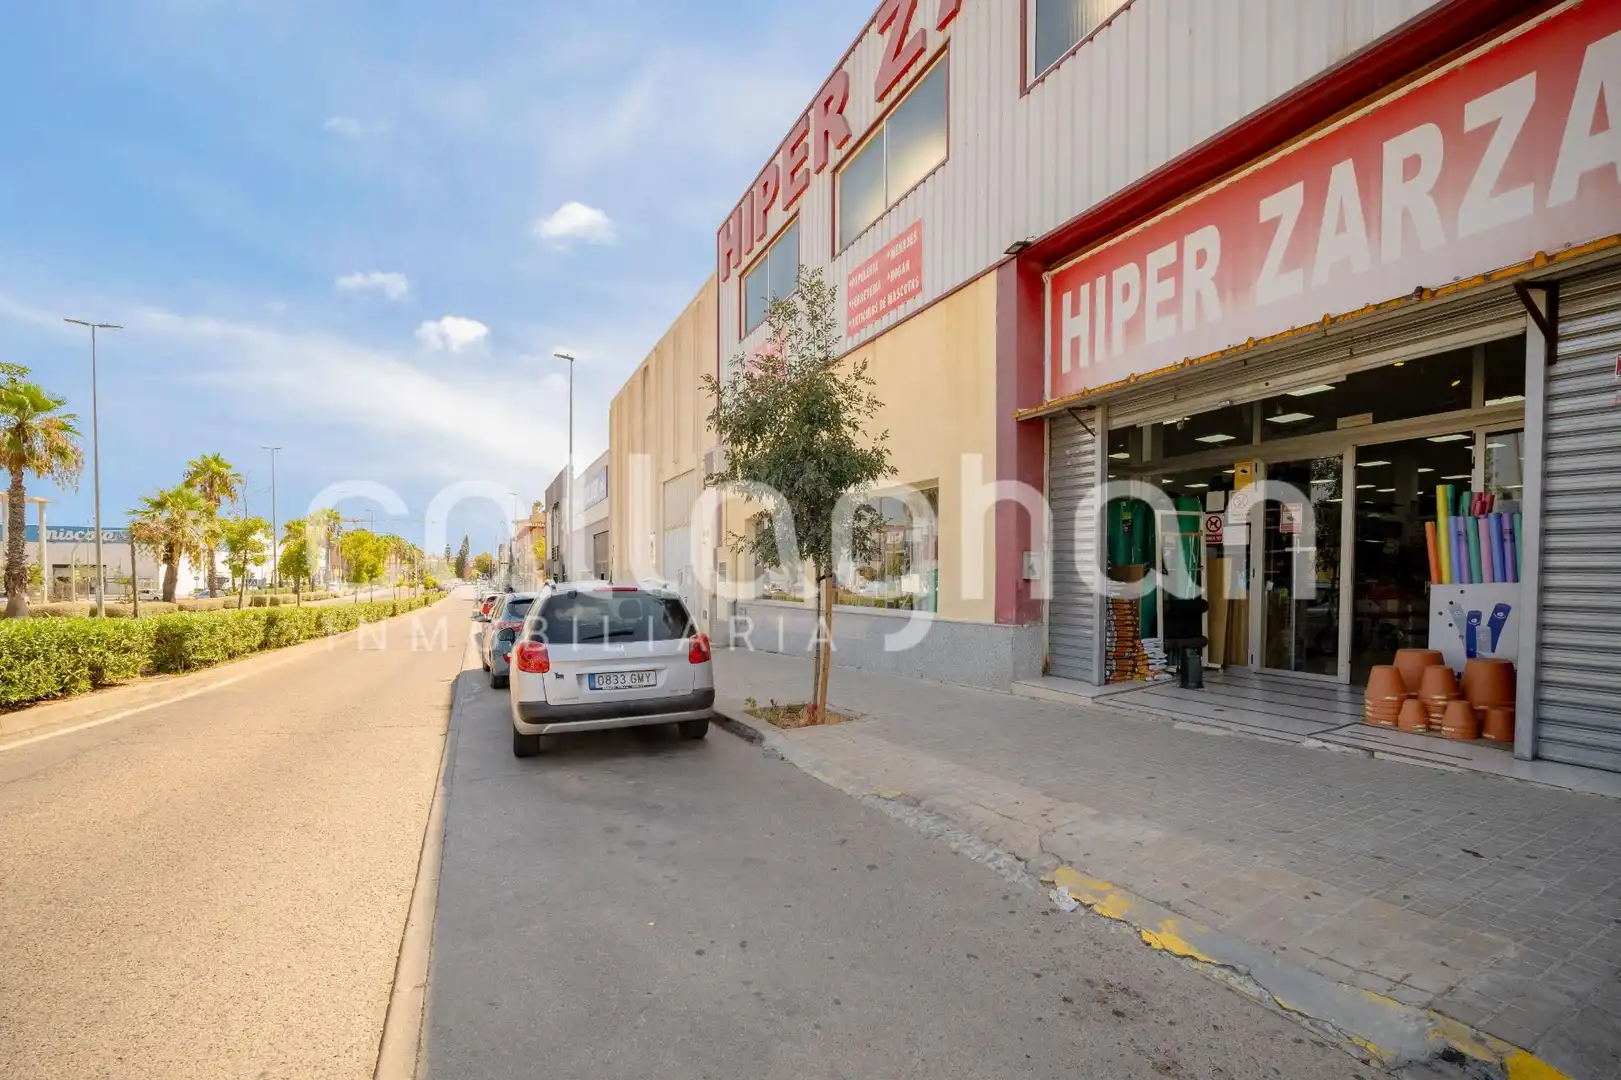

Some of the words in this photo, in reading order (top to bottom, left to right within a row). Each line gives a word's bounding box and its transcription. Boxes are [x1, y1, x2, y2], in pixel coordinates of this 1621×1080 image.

[718, 70, 852, 282] HIPER
[875, 0, 962, 103] Z
[1061, 225, 1223, 375] HIPER
[1255, 30, 1621, 305] ZARZA
[890, 260, 910, 283] HOGAR
[880, 296, 887, 311] DE
[887, 276, 919, 305] MASCOTAS
[598, 674, 626, 685] 0833
[631, 673, 651, 683] GMY
